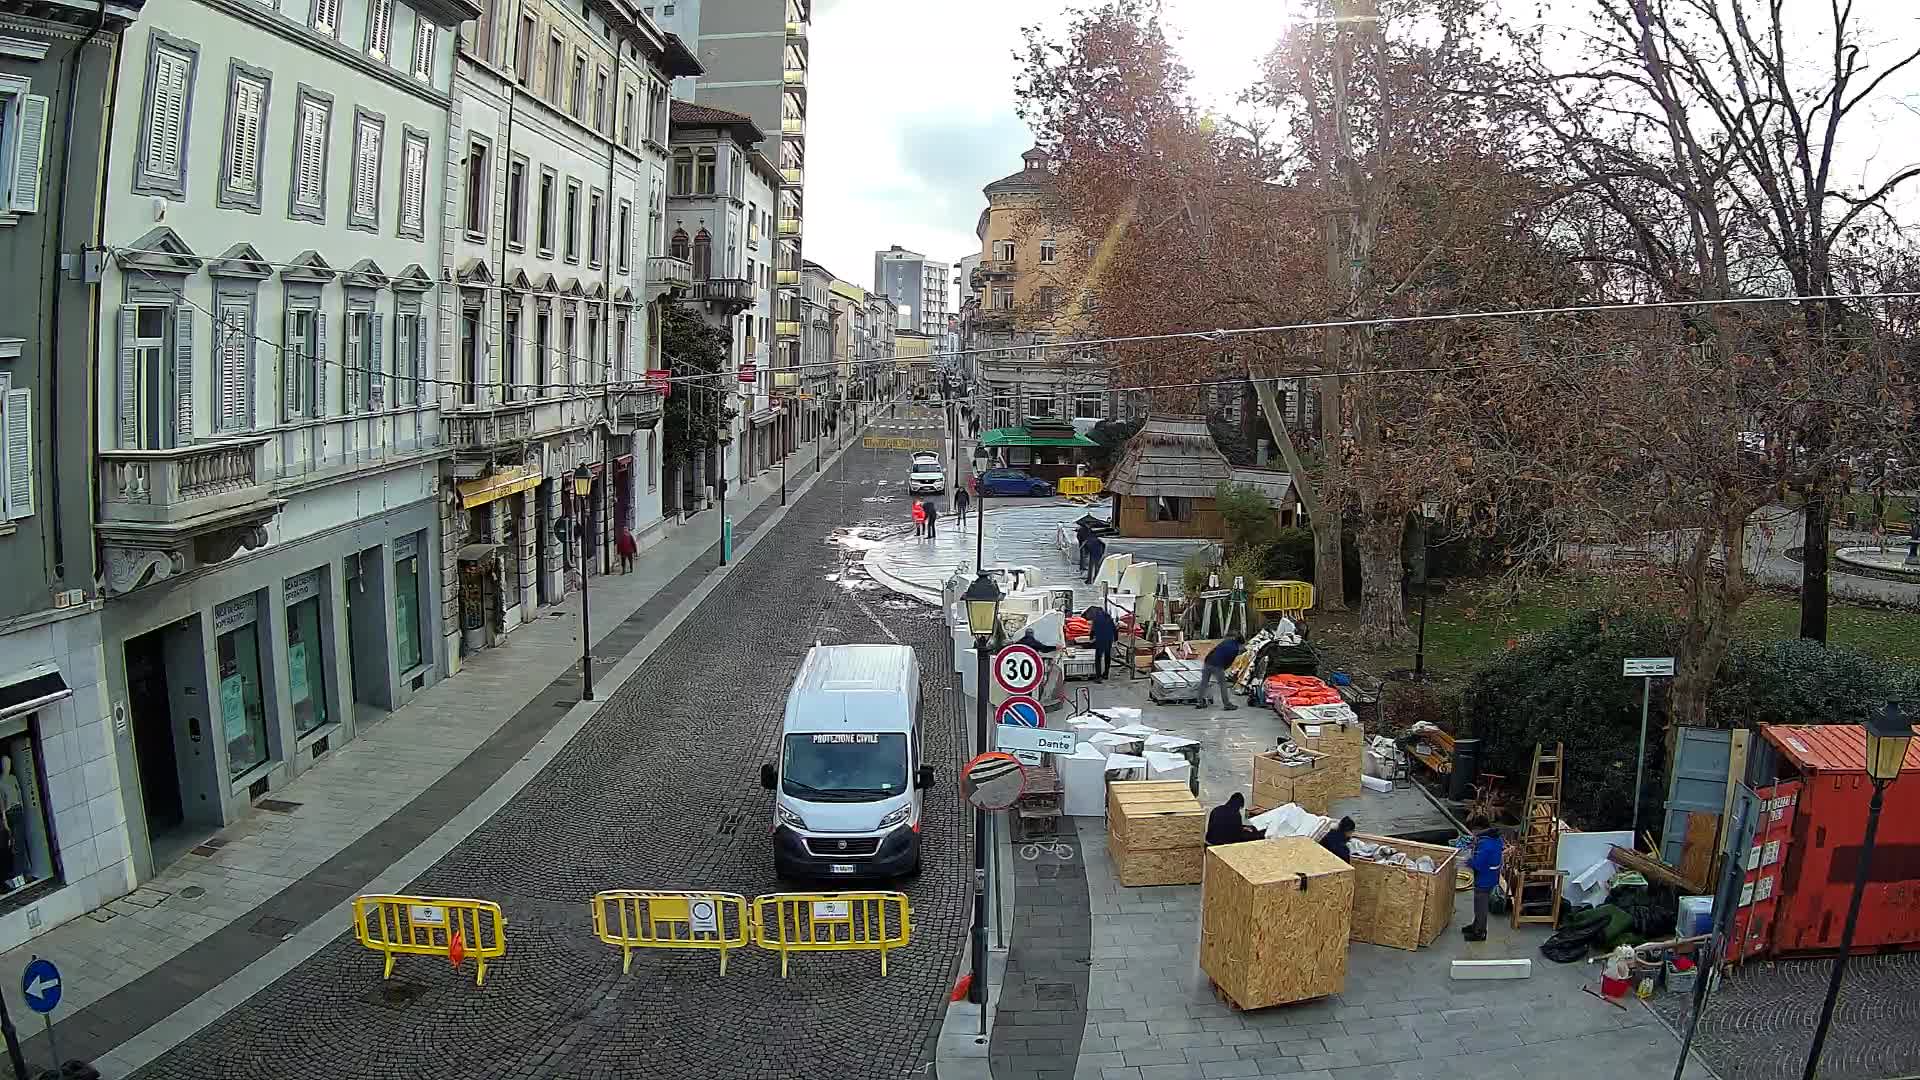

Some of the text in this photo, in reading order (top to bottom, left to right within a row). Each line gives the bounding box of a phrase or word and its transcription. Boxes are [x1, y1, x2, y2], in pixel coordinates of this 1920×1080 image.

[1006, 658, 1032, 680] 30
[813, 734, 879, 744] PROTEZIONE CIVILE
[1038, 738, 1070, 750] Dante
